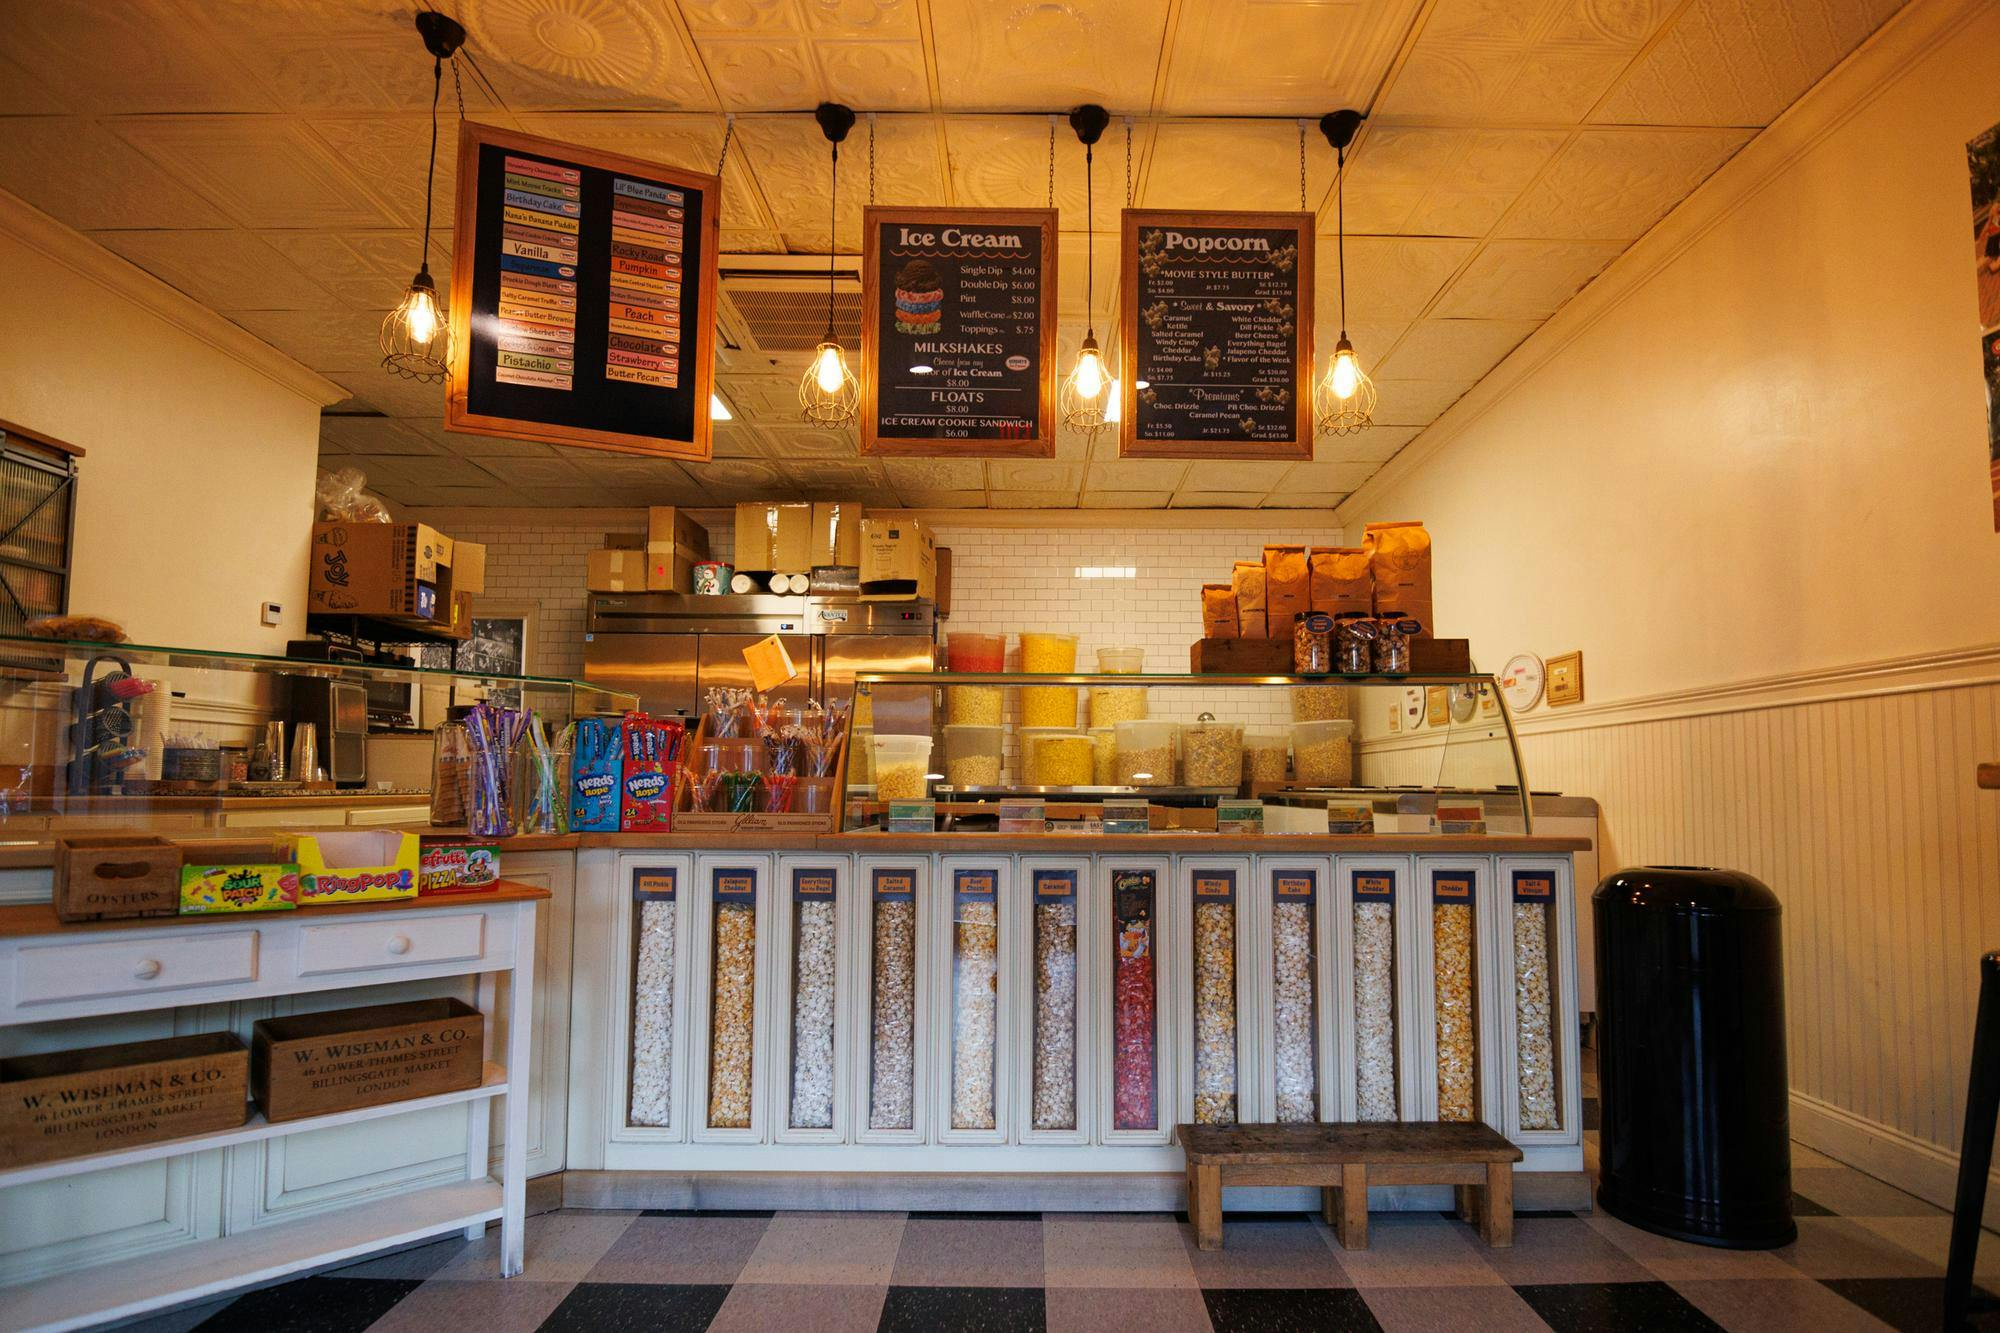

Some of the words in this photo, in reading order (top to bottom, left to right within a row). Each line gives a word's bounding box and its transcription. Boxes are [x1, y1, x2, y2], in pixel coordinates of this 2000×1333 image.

[542, 185, 561, 193] Tracks
[627, 185, 644, 196] Blue
[645, 189, 666, 200] Panda
[507, 193, 542, 208] Birthday
[543, 200, 562, 211] Cake
[505, 211, 527, 221] Nana's
[528, 215, 553, 225] Banana
[554, 220, 578, 230] Puddin'
[900, 228, 935, 246] Ice
[942, 229, 1022, 248] Cream
[1165, 232, 1270, 253] Popcorn
[515, 243, 548, 259] Vanilla
[613, 245, 639, 260] Rocky
[642, 249, 665, 263] Road
[619, 261, 658, 276] Pumpkin
[960, 266, 986, 276] Single
[988, 267, 1002, 276] Dip
[1013, 267, 1035, 275] $4.00
[1165, 270, 1195, 278] MOVIE
[1231, 271, 1270, 279] BUTTER
[630, 280, 646, 288] Central
[960, 280, 991, 289] Double
[993, 282, 1008, 291] Dip
[1012, 281, 1034, 290] $6.00
[502, 292, 517, 301] Salty
[518, 294, 540, 303] Caramel
[541, 297, 557, 305] Truffle
[960, 295, 976, 303] Pint
[1012, 295, 1034, 304] $8.00
[1181, 300, 1202, 311] Sweet
[1216, 302, 1255, 313] Savory
[525, 311, 547, 320] Butter
[548, 314, 573, 323] Brownie
[625, 308, 654, 321] Peach
[1013, 311, 1034, 320] $2.00
[530, 327, 555, 336] Sherbet
[960, 325, 998, 335] Toppings
[1016, 326, 1034, 334] $.75
[610, 336, 661, 354] Chocolate
[915, 343, 1003, 354] MILKSHAKES
[1179, 339, 1199, 347] Cindy
[1228, 340, 1265, 348] Everything
[503, 354, 551, 370] Pistachio
[609, 352, 660, 369] Strawberry
[934, 357, 954, 366] Choose
[957, 358, 971, 368] from
[972, 360, 983, 368] any
[1153, 355, 1182, 363] Birthday
[608, 368, 635, 379] Butter
[637, 372, 660, 382] Pecan
[942, 368, 951, 376] of
[947, 379, 969, 387] $8.00
[931, 392, 984, 402] FLOATS
[1193, 389, 1240, 402] Premiums
[946, 405, 969, 413] $8.00
[901, 418, 935, 426] CREAM
[938, 419, 976, 427] COOKIE
[980, 420, 1032, 428] SANDWICH
[946, 429, 968, 437] $6.00
[224, 878, 260, 889] SOUR
[420, 869, 456, 891] PIZZA
[87, 891, 159, 904] OYSTERS
[223, 887, 262, 900] PATCH
[294, 1050, 318, 1062] W.
[326, 1036, 415, 1058] WISEMAN
[421, 1034, 433, 1045] &
[440, 1029, 470, 1042] CO.
[320, 1061, 364, 1074] LOWER
[367, 1053, 416, 1067] THAMES
[420, 1045, 461, 1058] STREET
[312, 1069, 399, 1088] BILLINGSGATE
[405, 1060, 451, 1073] MARKET
[23, 1095, 52, 1109] W.
[60, 1078, 162, 1104] WISEMAN
[170, 1074, 184, 1087] &
[192, 1070, 226, 1083] CO.
[356, 1079, 410, 1094] LONDON
[53, 1104, 103, 1120] LOWER
[109, 1094, 165, 1110] THAMES
[169, 1085, 215, 1098] STREET
[44, 1112, 143, 1136] BILLINGSGATE
[152, 1101, 203, 1117] MARKET
[96, 1122, 158, 1139] LONDON
